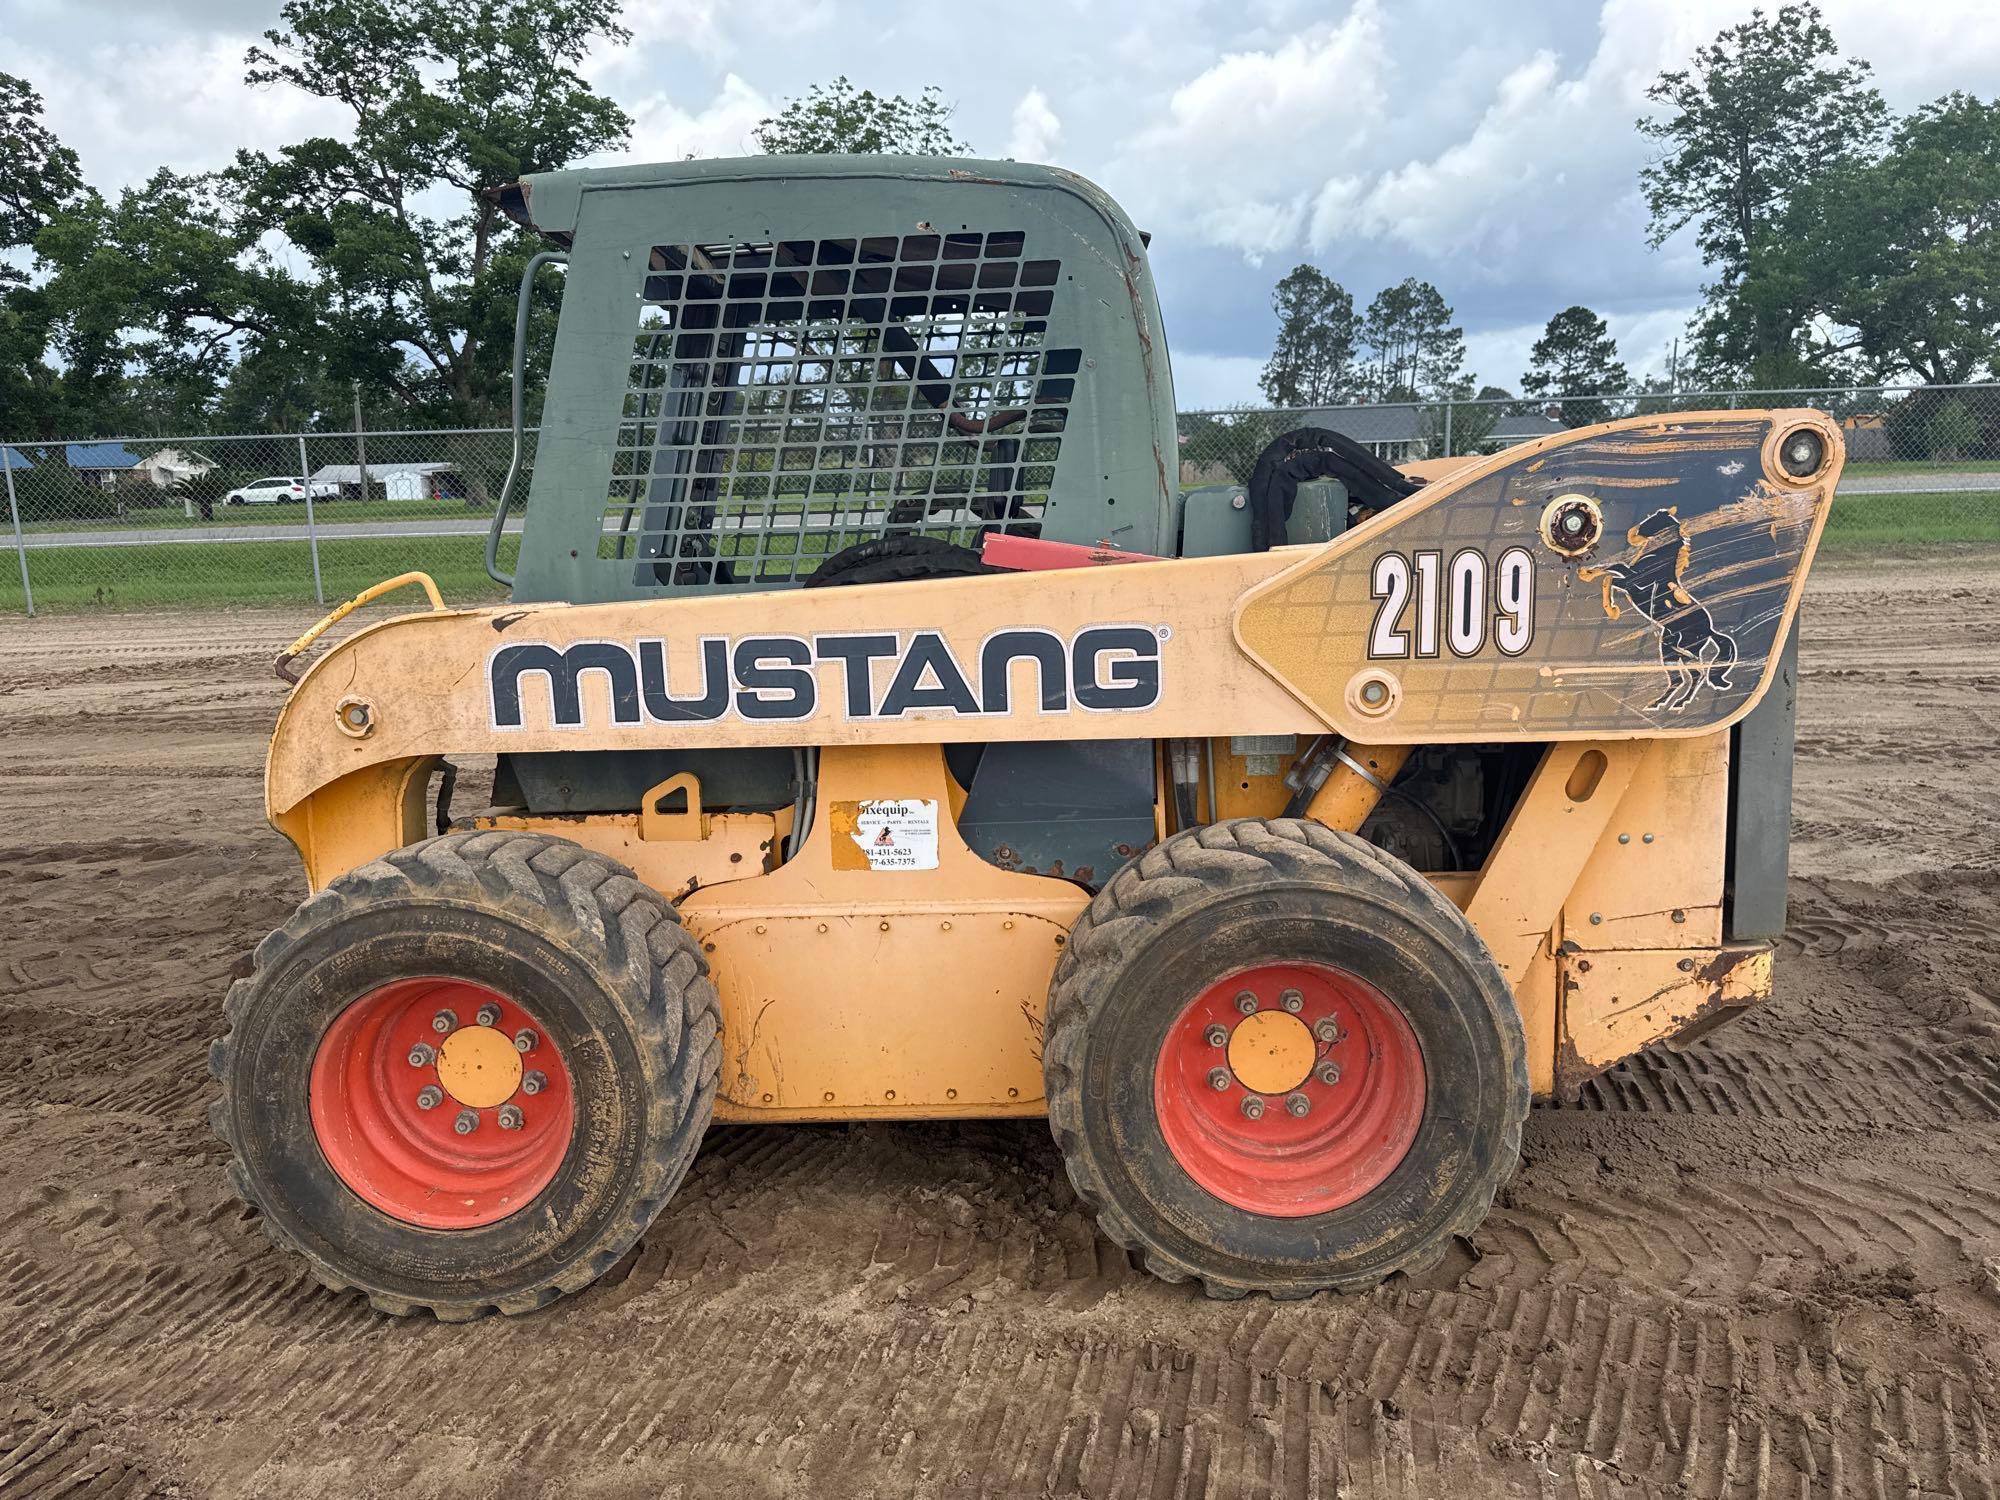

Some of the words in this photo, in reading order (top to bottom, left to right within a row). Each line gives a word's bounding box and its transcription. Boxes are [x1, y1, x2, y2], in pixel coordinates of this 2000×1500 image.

[1368, 545, 1537, 660] 2109
[489, 626, 1162, 730] MUSTANG
[623, 1118, 638, 1169] NUMBER
